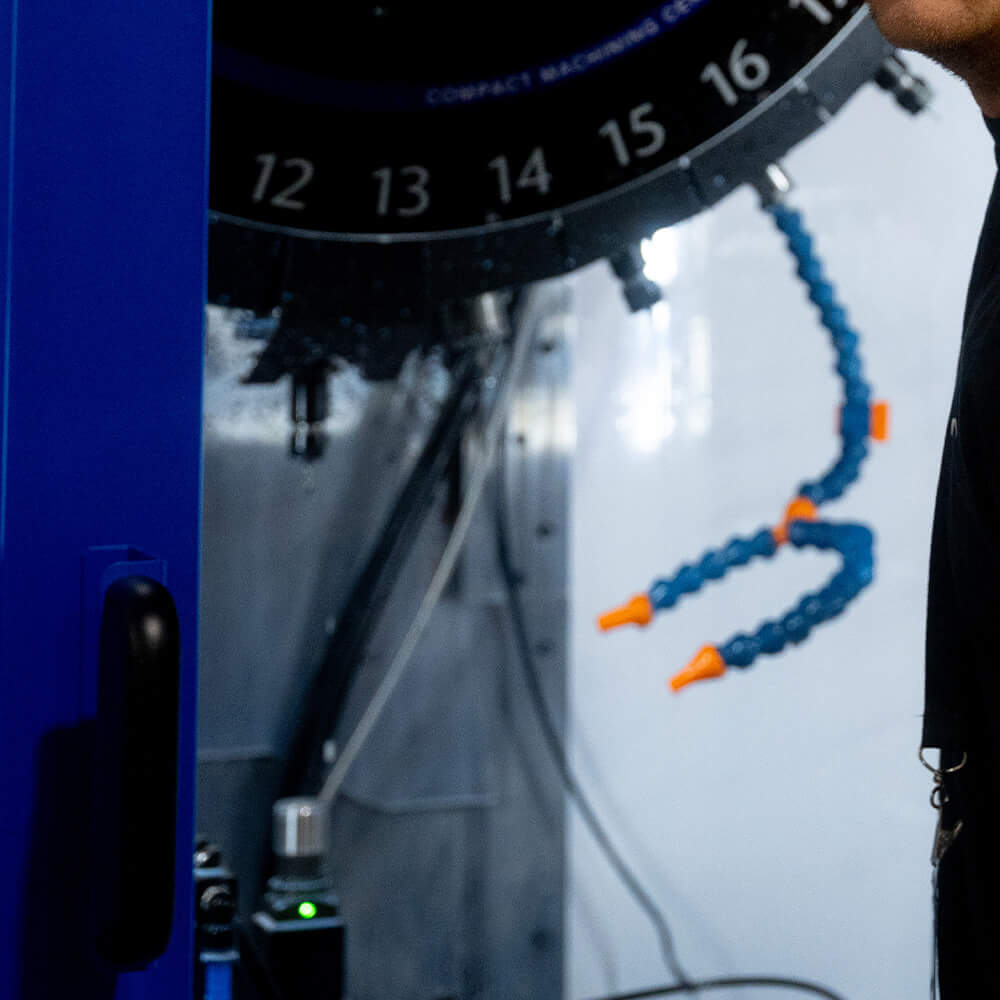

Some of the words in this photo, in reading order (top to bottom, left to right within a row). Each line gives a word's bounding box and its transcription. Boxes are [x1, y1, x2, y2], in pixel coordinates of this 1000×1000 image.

[424, 71, 534, 106] COMPACT
[539, 16, 661, 84] MACHINING
[699, 37, 771, 107] 16
[599, 101, 668, 167] 15
[251, 151, 316, 211] 12
[372, 163, 431, 218] 13
[487, 145, 553, 205] 14
